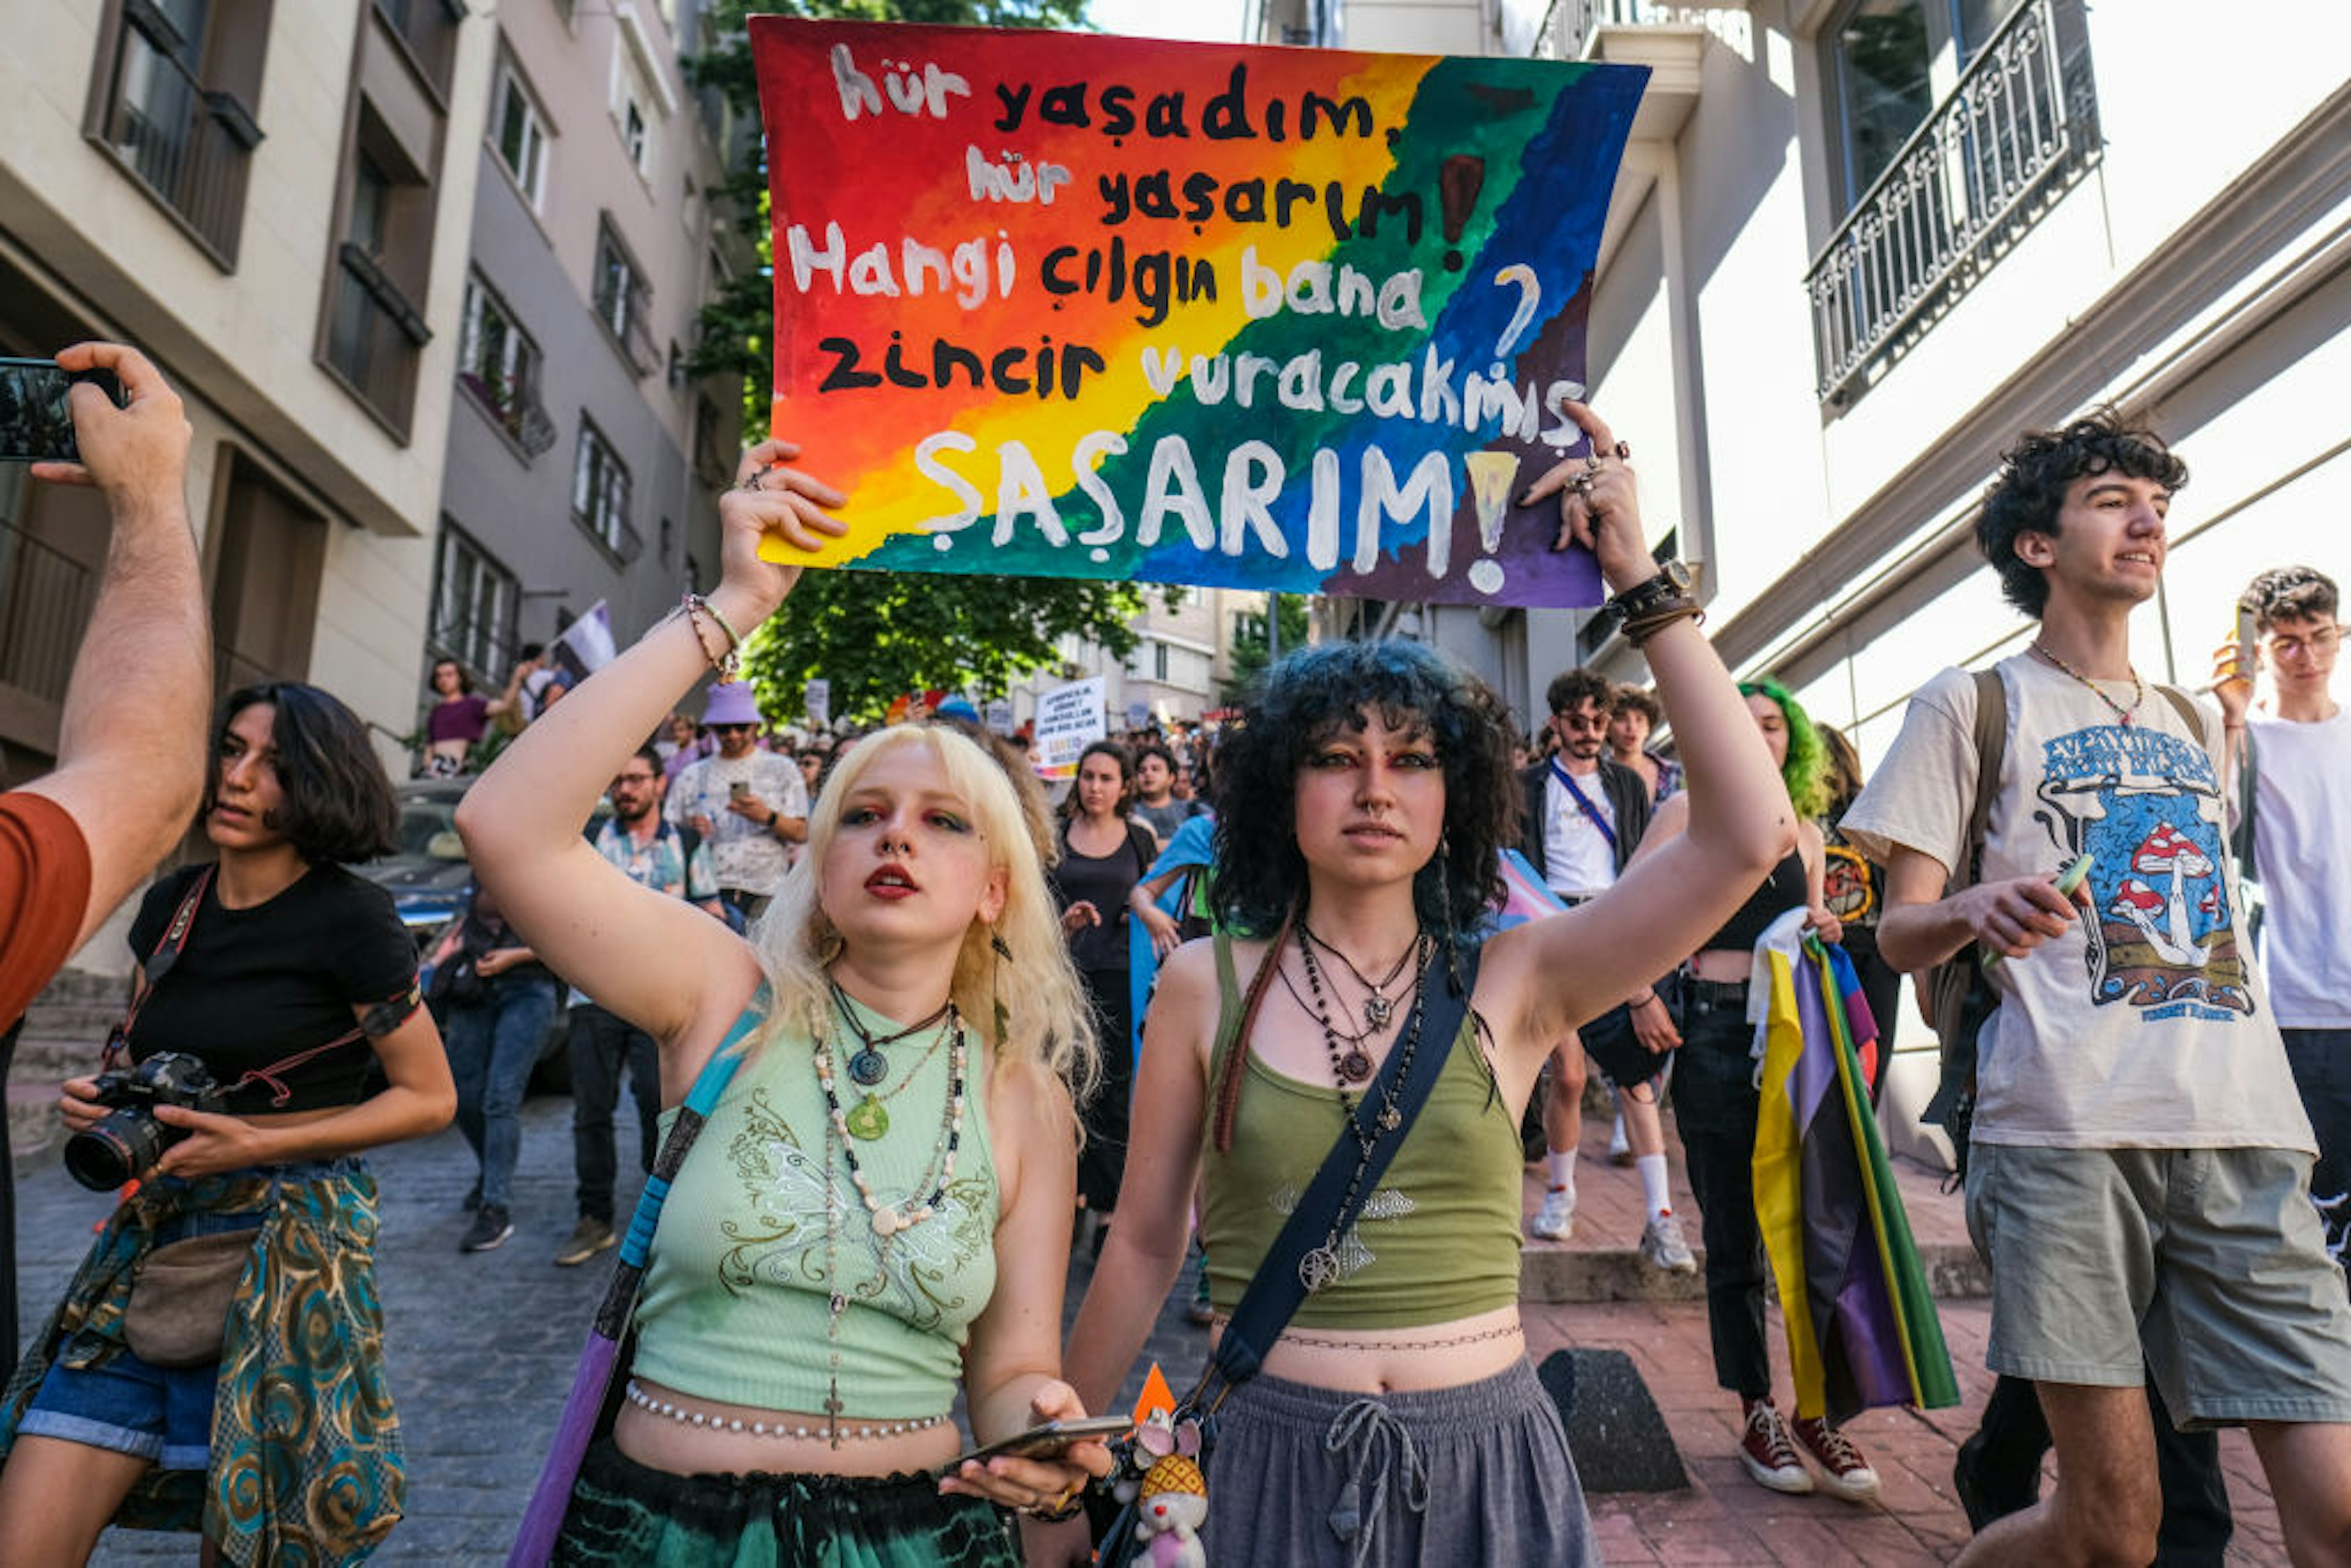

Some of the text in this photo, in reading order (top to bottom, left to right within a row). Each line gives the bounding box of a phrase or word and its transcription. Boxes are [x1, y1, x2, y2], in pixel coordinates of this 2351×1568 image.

[830, 43, 971, 120] hür
[966, 144, 1073, 206] hür
[787, 220, 1427, 331] Hangi çılgın bana
[819, 331, 1106, 399] zincir
[915, 430, 1521, 594] ŞAŞARIM!
